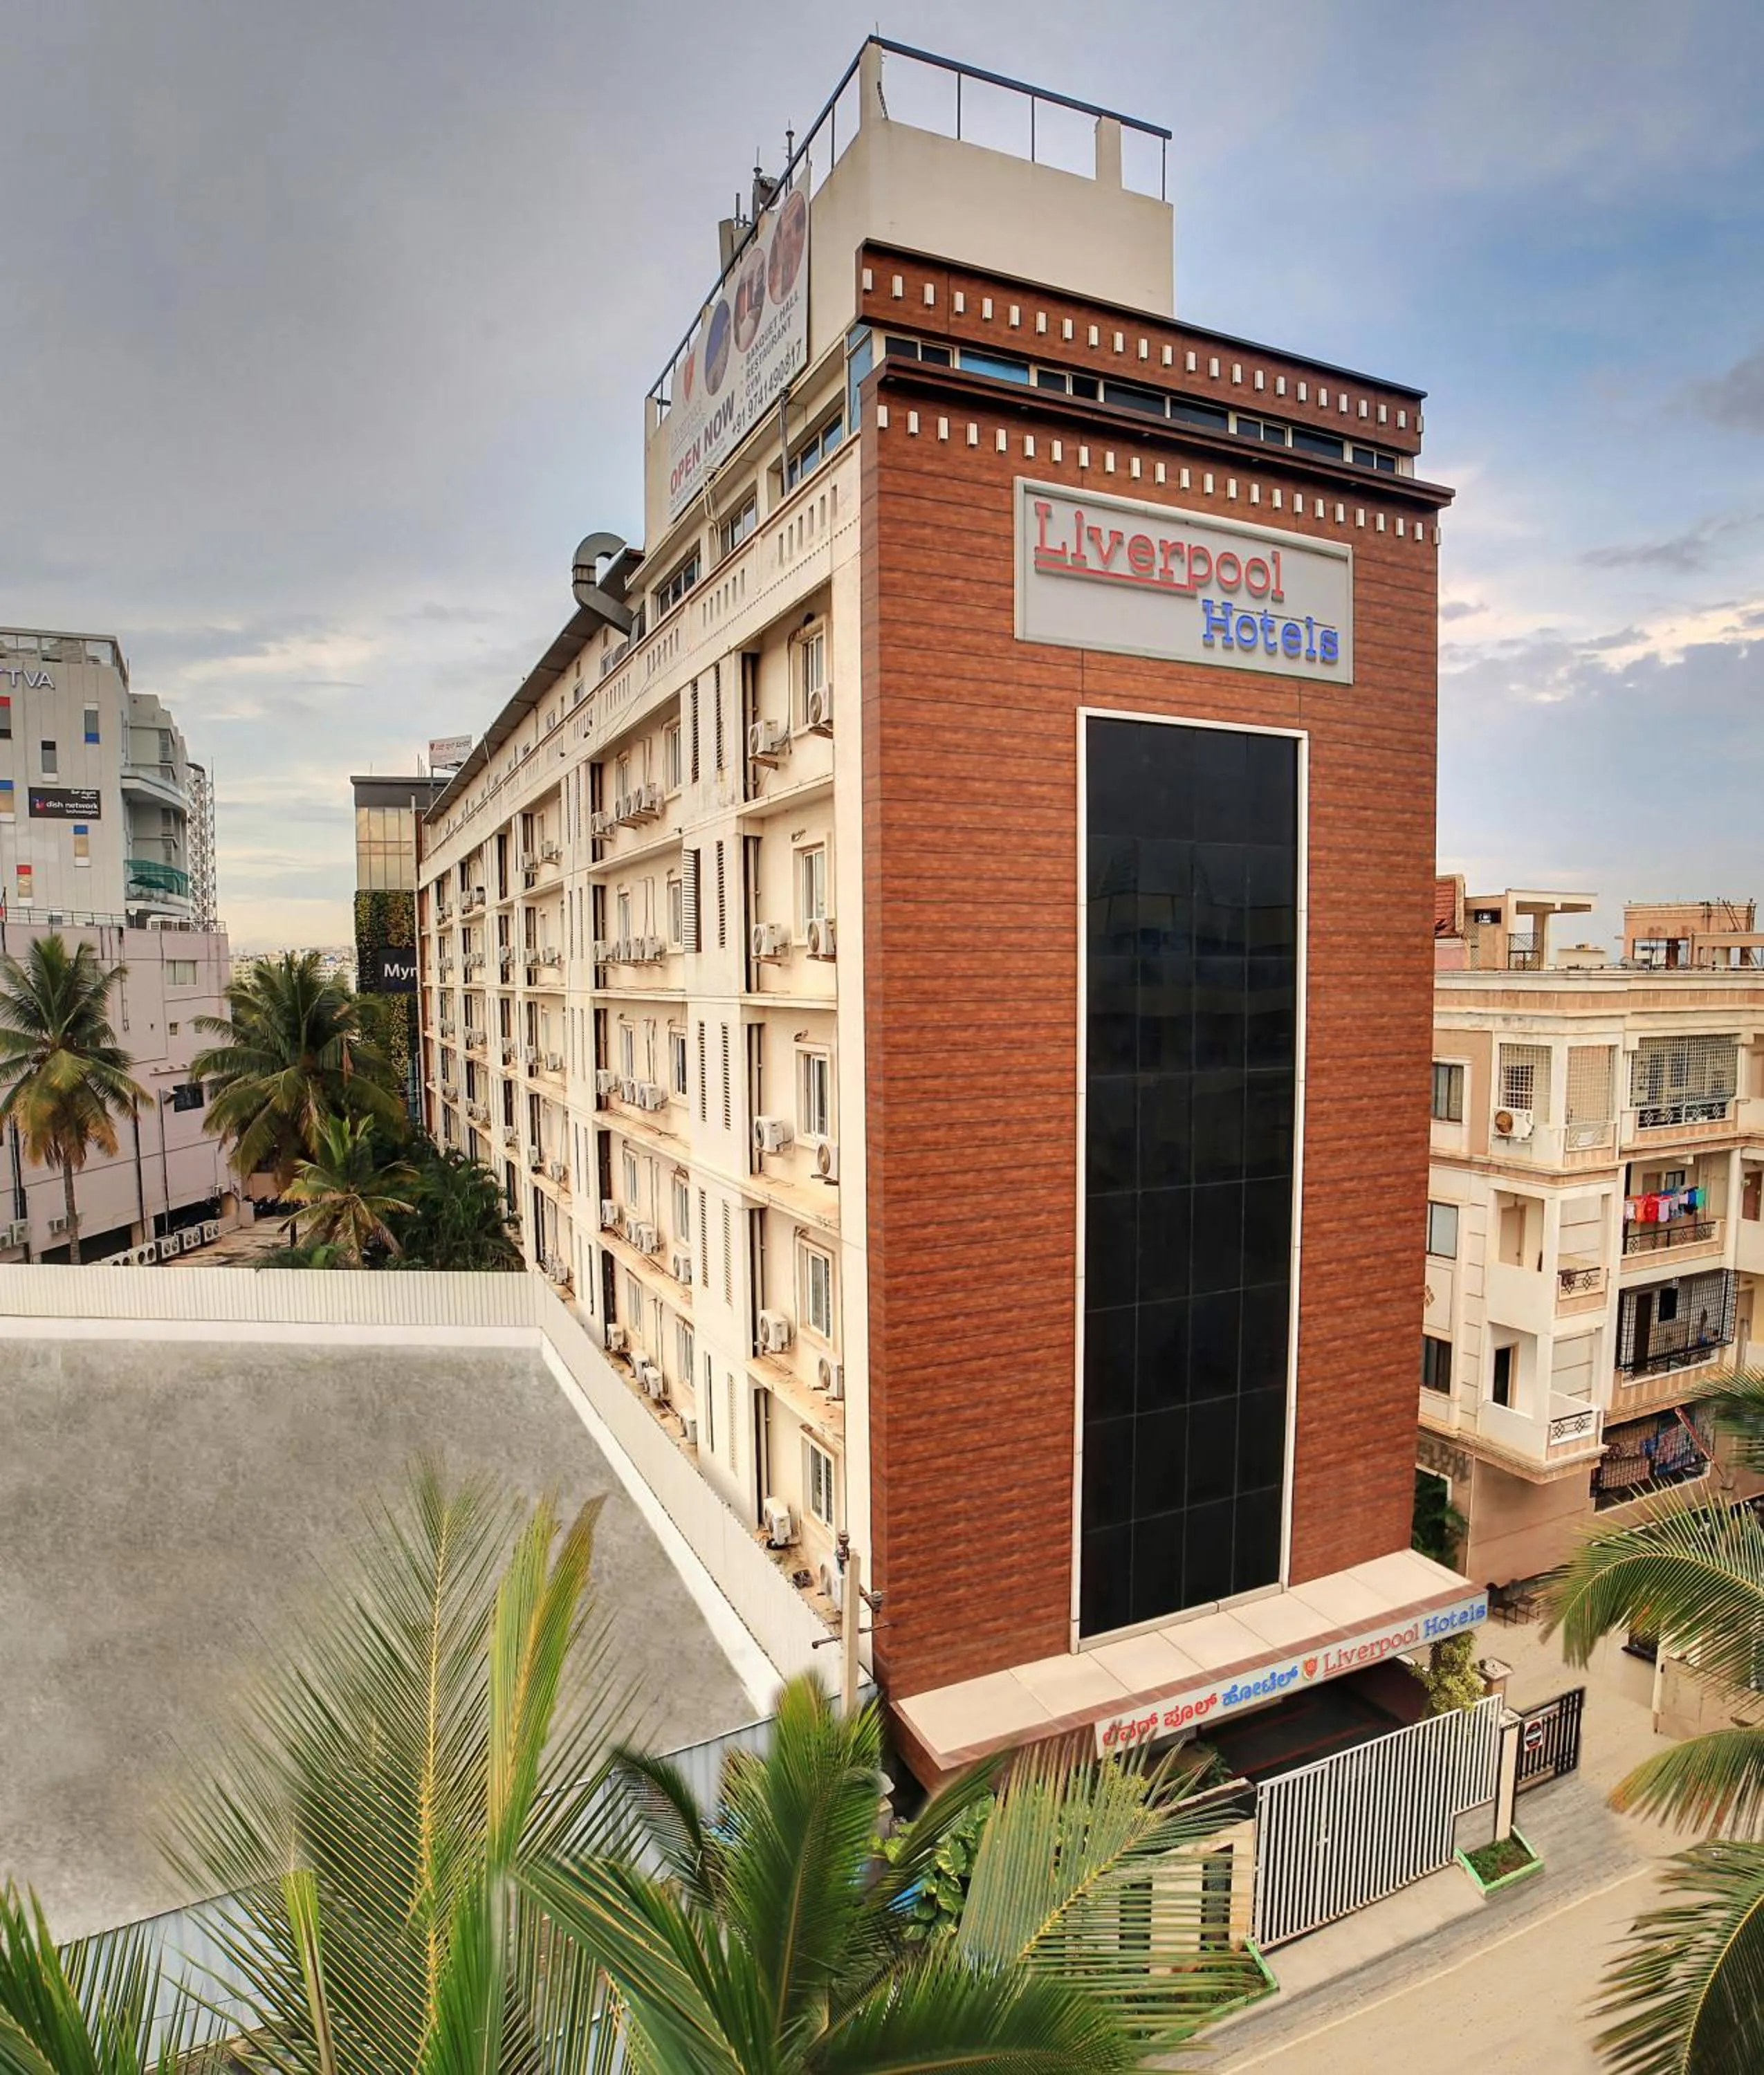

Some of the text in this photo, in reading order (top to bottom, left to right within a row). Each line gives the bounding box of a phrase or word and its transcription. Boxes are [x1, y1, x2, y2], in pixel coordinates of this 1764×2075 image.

[746, 313, 791, 378] RESTAURANT
[670, 436, 701, 496] OPEN
[704, 390, 735, 453] NOW
[1033, 500, 1285, 602] Liverpool
[1202, 598, 1339, 665] Hotels
[0, 669, 55, 689] TVA
[46, 800, 64, 809] dish
[1323, 1603, 1486, 1674] Liverpool Hotels
